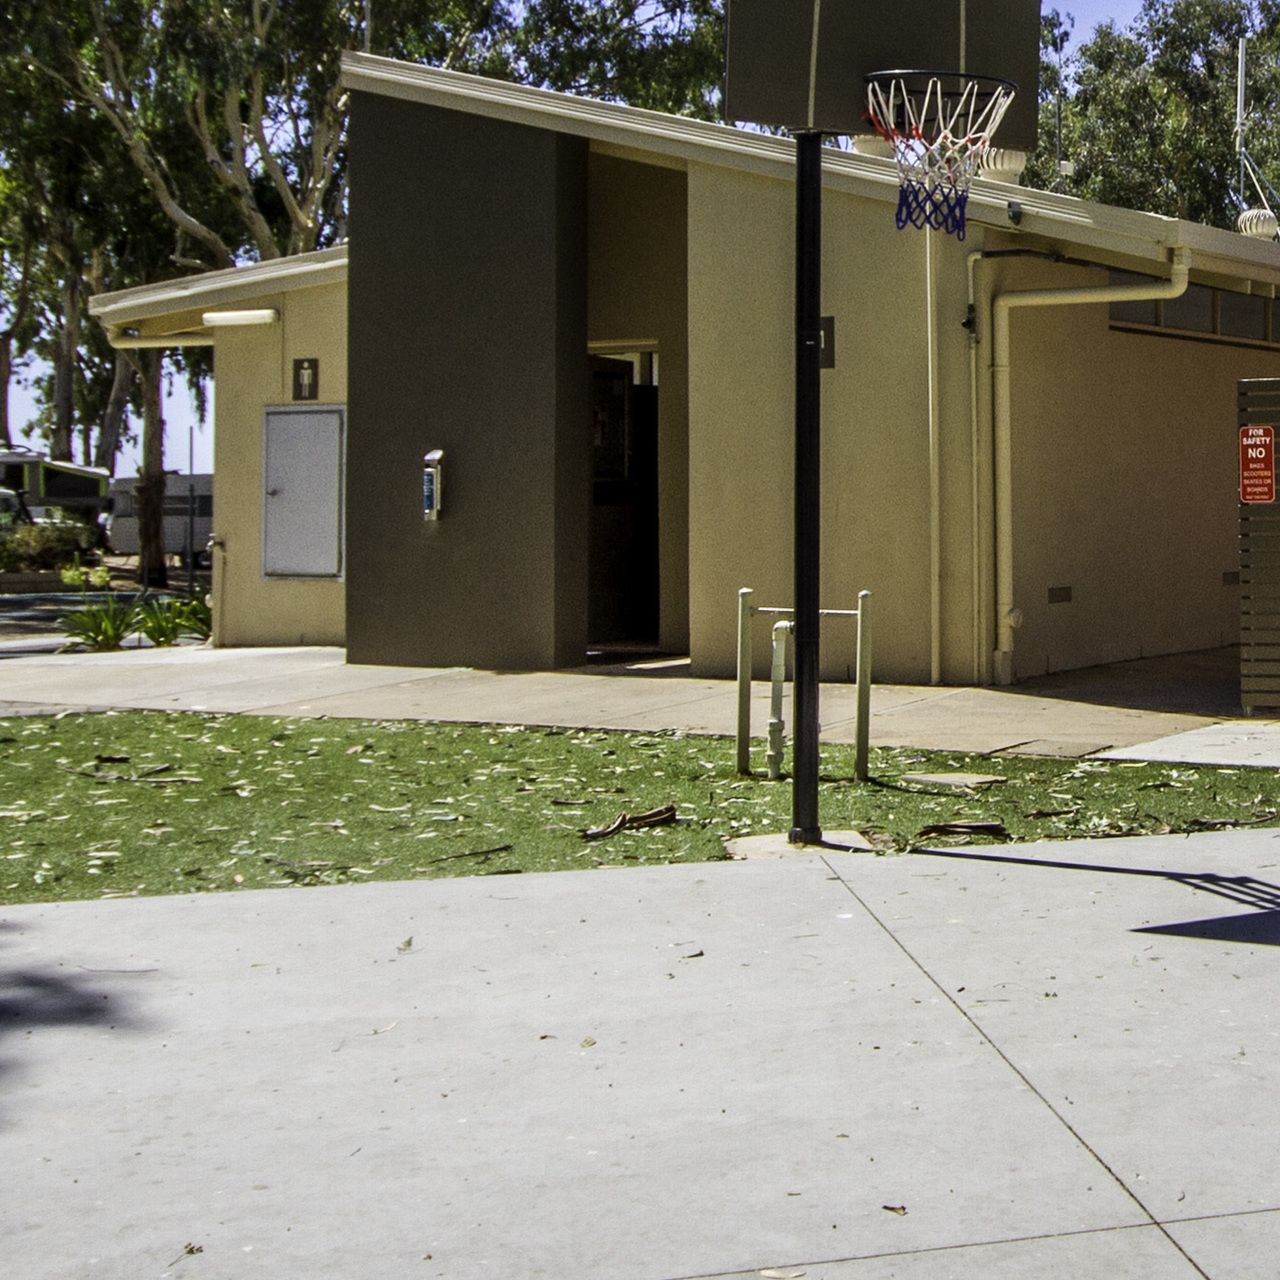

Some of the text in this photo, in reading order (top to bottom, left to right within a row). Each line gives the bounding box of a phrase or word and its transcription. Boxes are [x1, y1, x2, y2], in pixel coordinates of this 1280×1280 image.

[1249, 428, 1264, 436] FOR
[1242, 437, 1271, 445] SAFETY
[1248, 447, 1265, 458] NO
